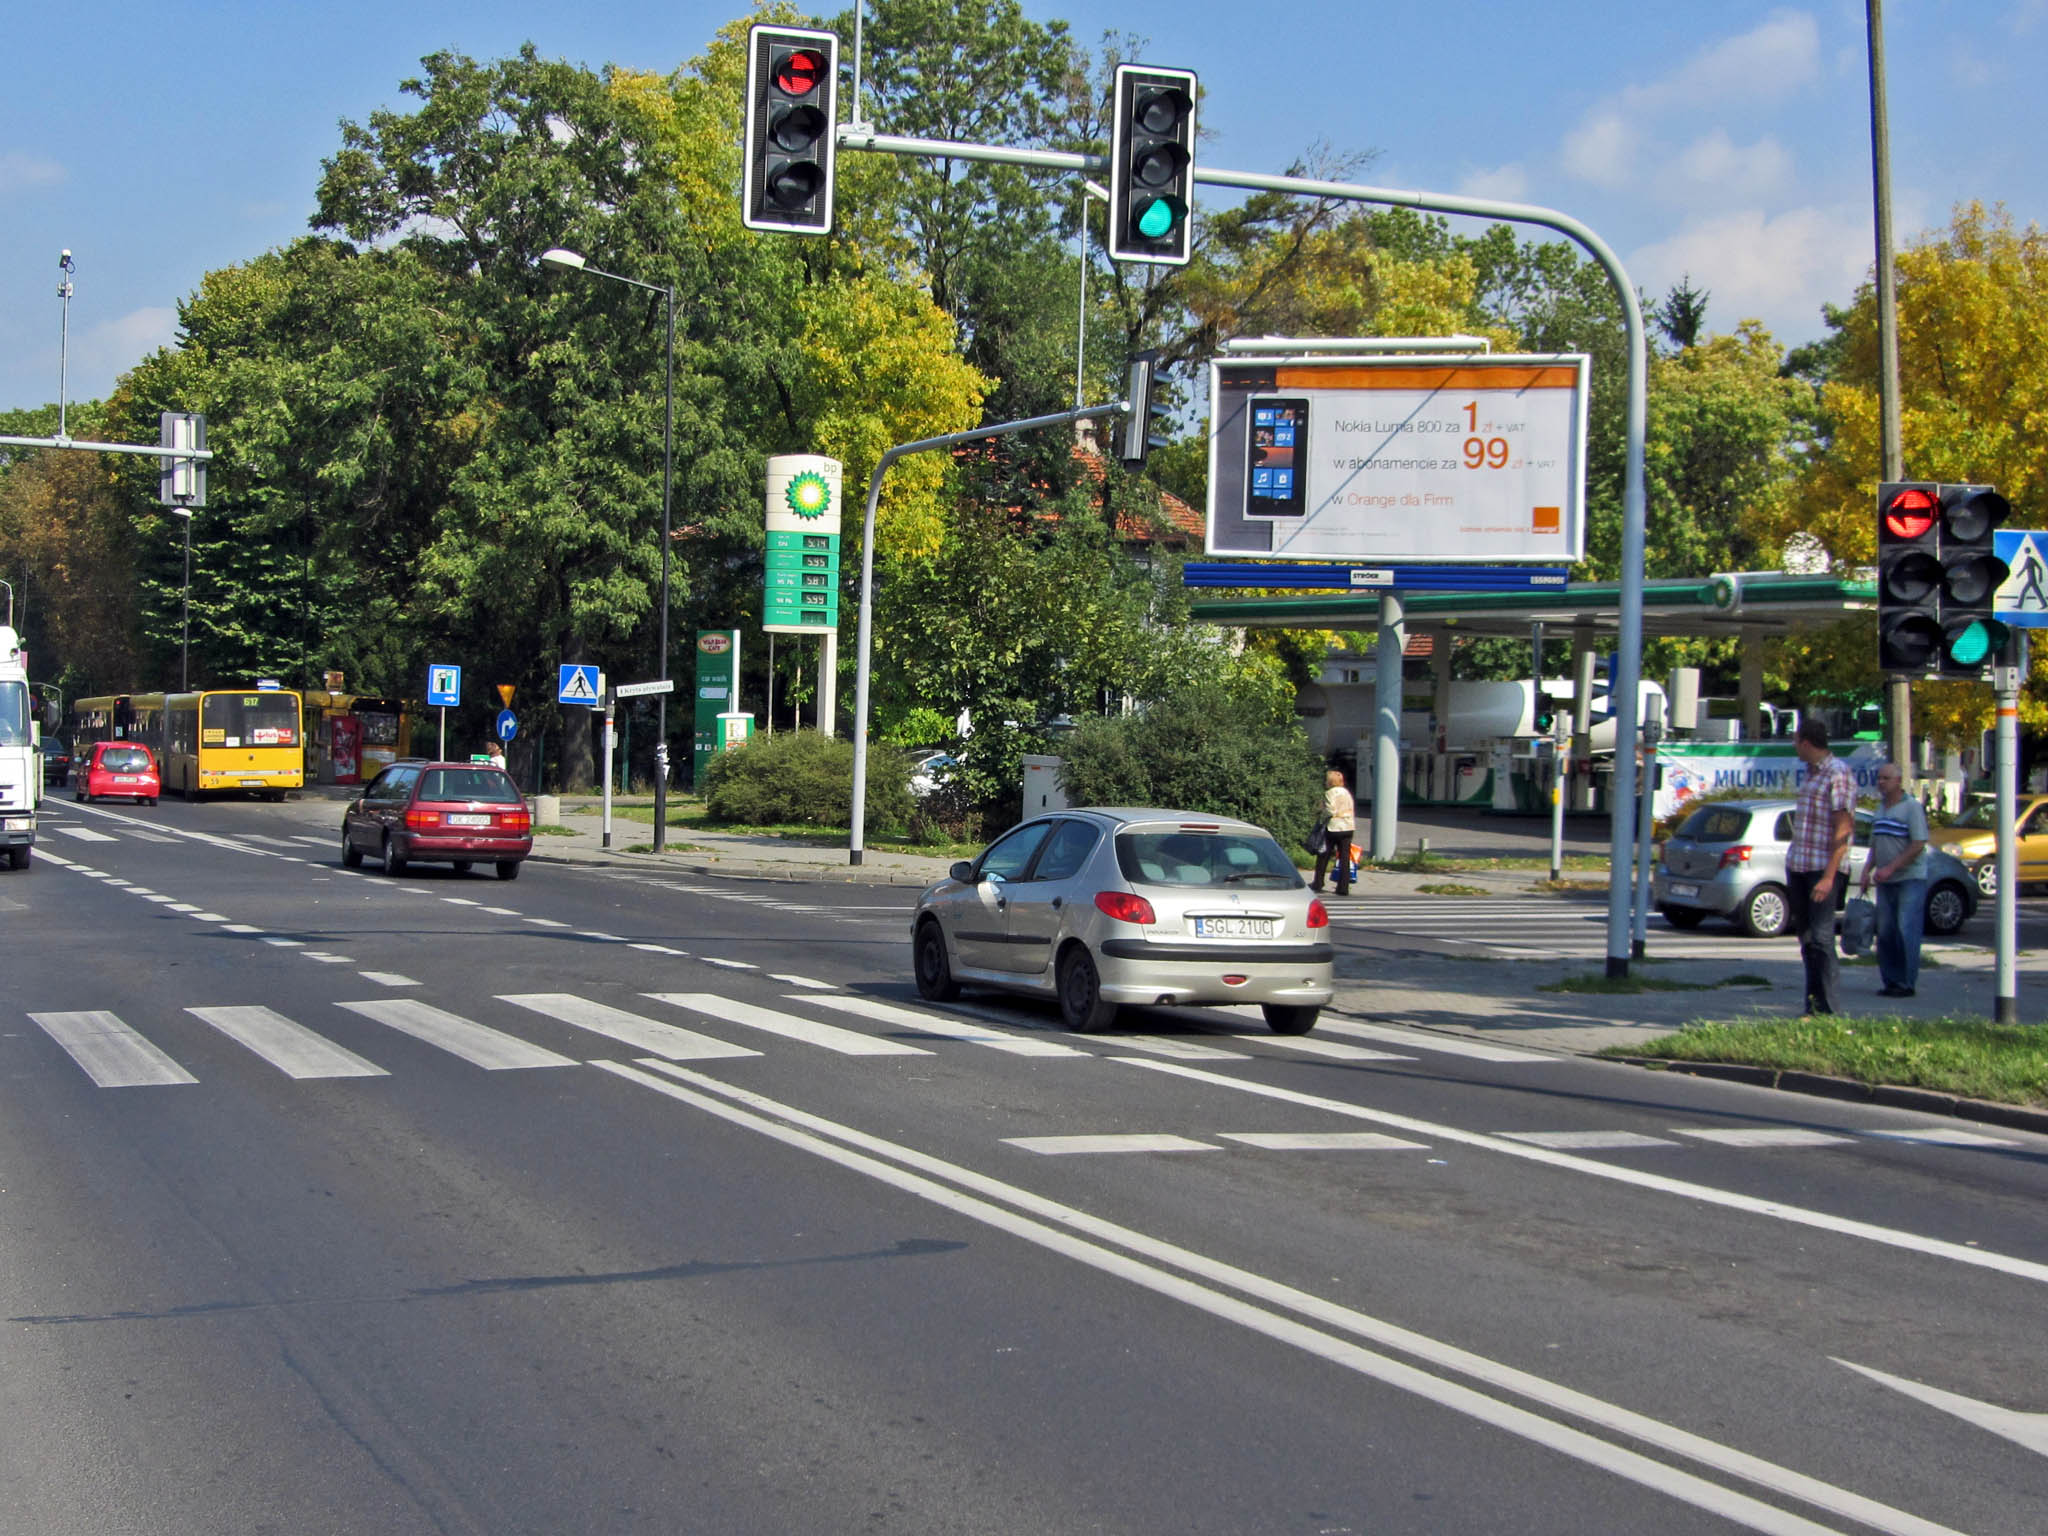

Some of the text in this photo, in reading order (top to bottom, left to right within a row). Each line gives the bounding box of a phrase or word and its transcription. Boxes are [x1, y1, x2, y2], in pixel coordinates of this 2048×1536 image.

[1335, 420, 1371, 433] Nokia
[1375, 420, 1413, 433] Lumia
[1417, 420, 1441, 433] 800
[1445, 423, 1460, 433] za
[1463, 401, 1478, 433] 1
[1506, 423, 1526, 433] VAT
[1333, 460, 1345, 469] w
[1349, 457, 1437, 470] abonamencie
[1441, 460, 1457, 470] za
[1463, 437, 1509, 470] 99
[824, 462, 838, 476] bp
[1332, 493, 1453, 508] w Orange dla Firm
[1714, 768, 1793, 788] MILIONY
[1204, 919, 1234, 934] SGL
